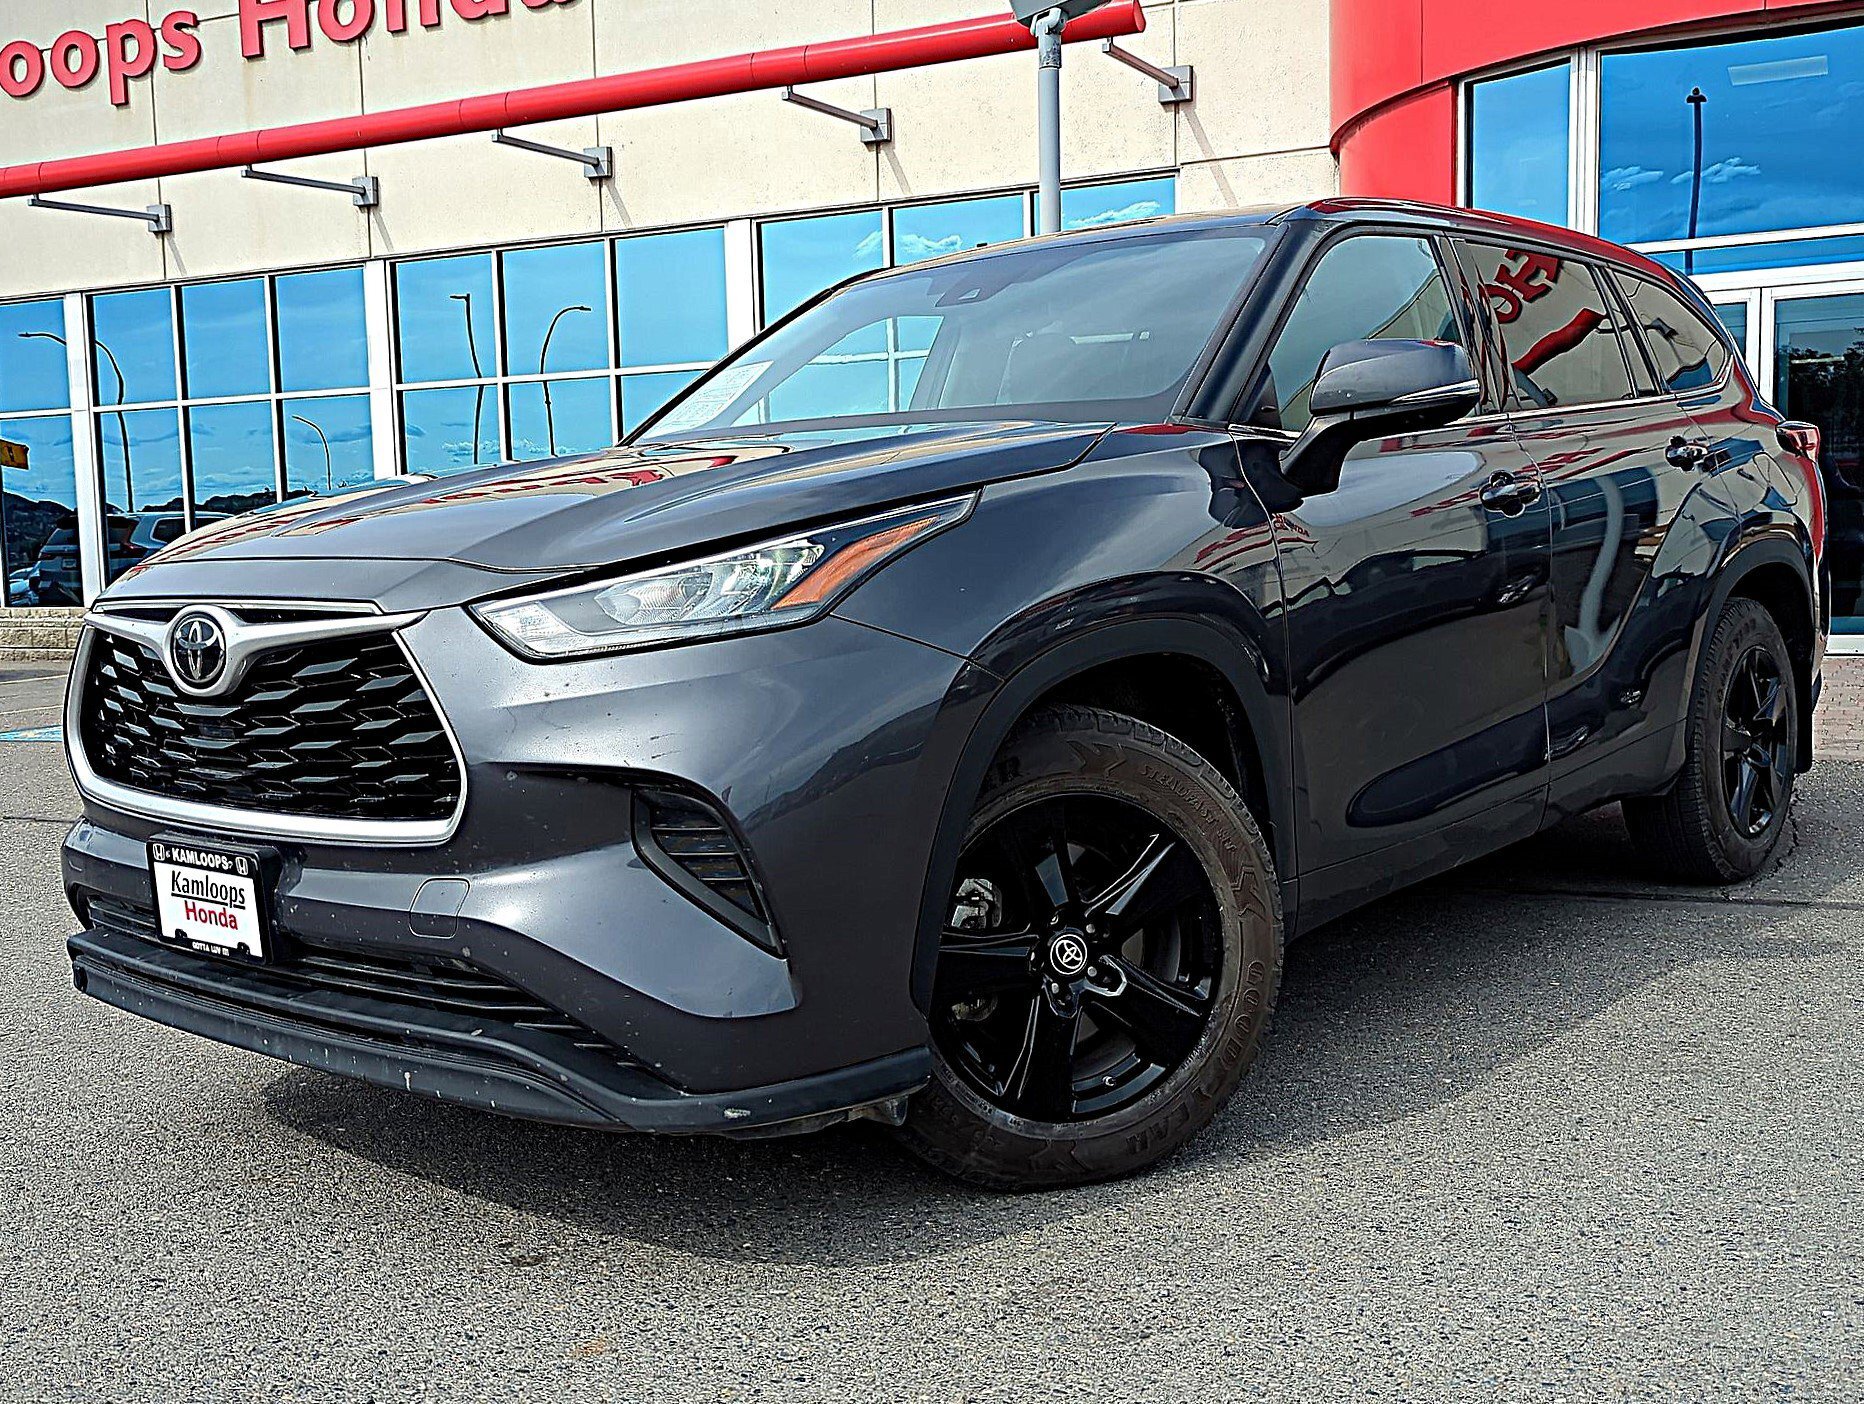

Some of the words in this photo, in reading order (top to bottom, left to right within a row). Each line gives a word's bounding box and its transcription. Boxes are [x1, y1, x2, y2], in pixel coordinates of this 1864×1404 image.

[171, 847, 229, 870] KAMLOOPS
[171, 870, 246, 908] Kamloops
[184, 900, 238, 930] Honda
